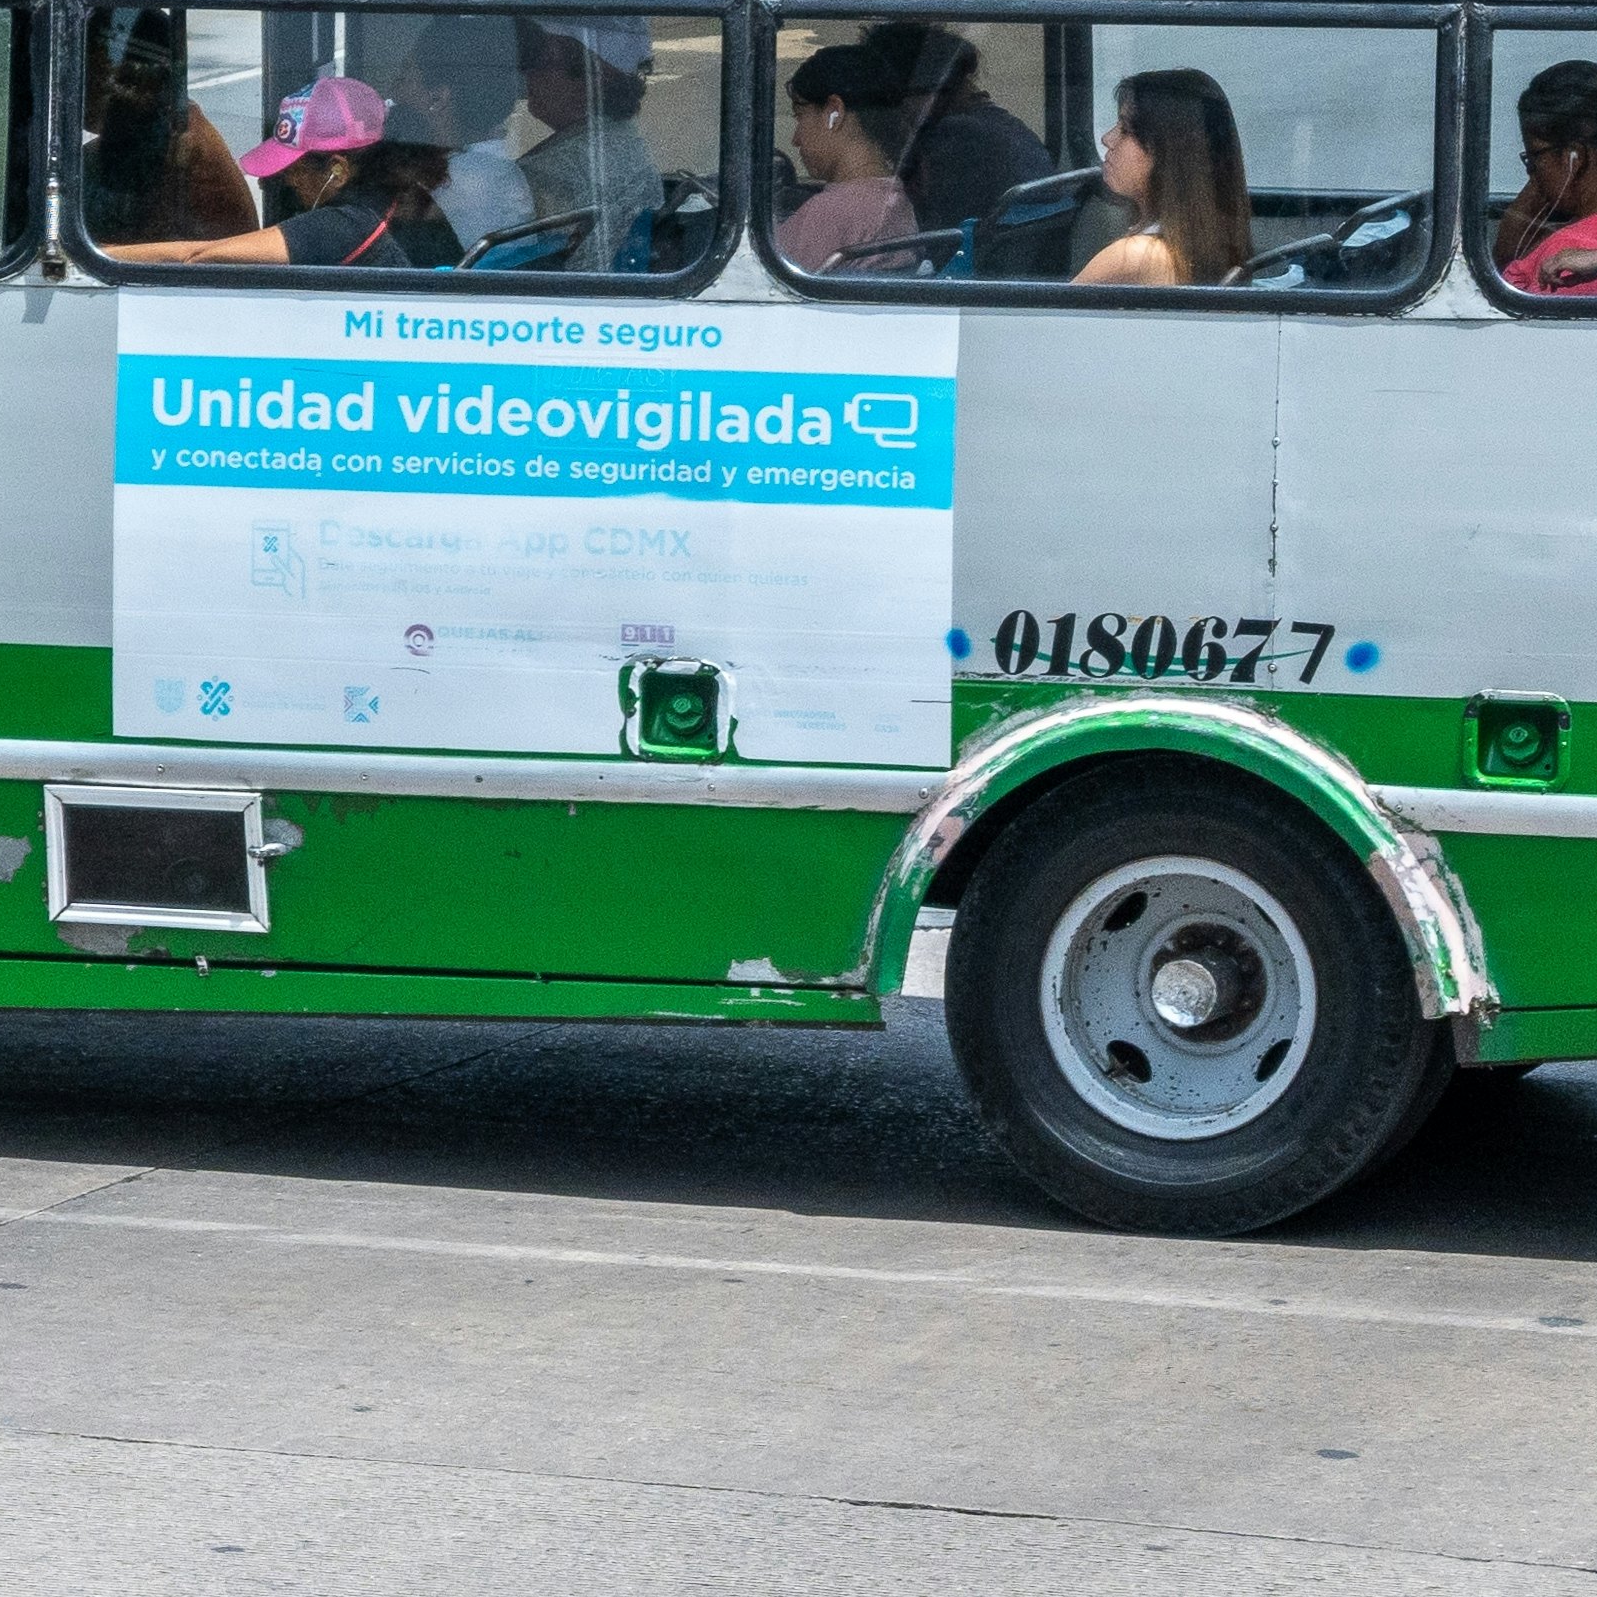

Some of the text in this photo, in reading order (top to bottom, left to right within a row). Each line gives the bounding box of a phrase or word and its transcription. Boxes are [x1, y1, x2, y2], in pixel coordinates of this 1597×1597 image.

[344, 309, 723, 353] Mi transporte seguro
[151, 377, 833, 452] Unidad videovigilada
[151, 449, 917, 492] y conectada con servicios de seguridad y emergencia
[583, 525, 692, 558] CDMX
[624, 624, 674, 643] 911
[994, 609, 1337, 685] 0180677
